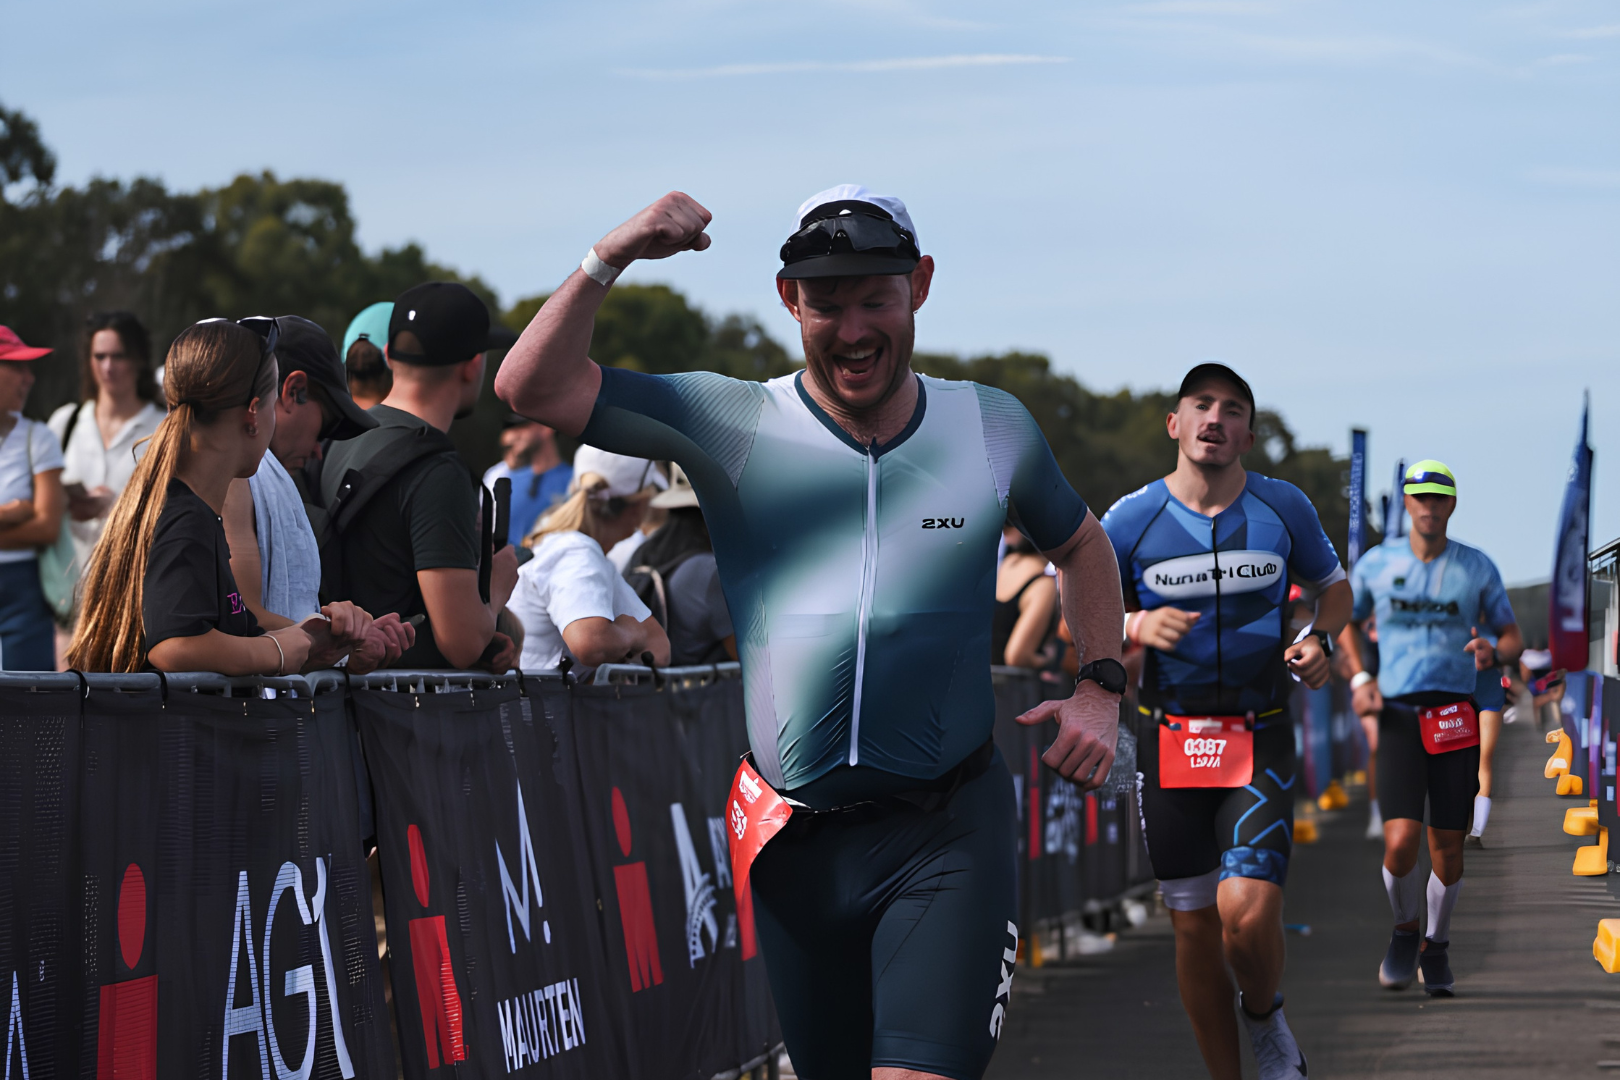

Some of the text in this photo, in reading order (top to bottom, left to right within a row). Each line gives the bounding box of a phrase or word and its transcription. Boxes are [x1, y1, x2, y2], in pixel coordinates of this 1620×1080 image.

[921, 517, 965, 529] 2XU
[1184, 738, 1227, 756] 0387
[497, 977, 586, 1074] MAURTEN
